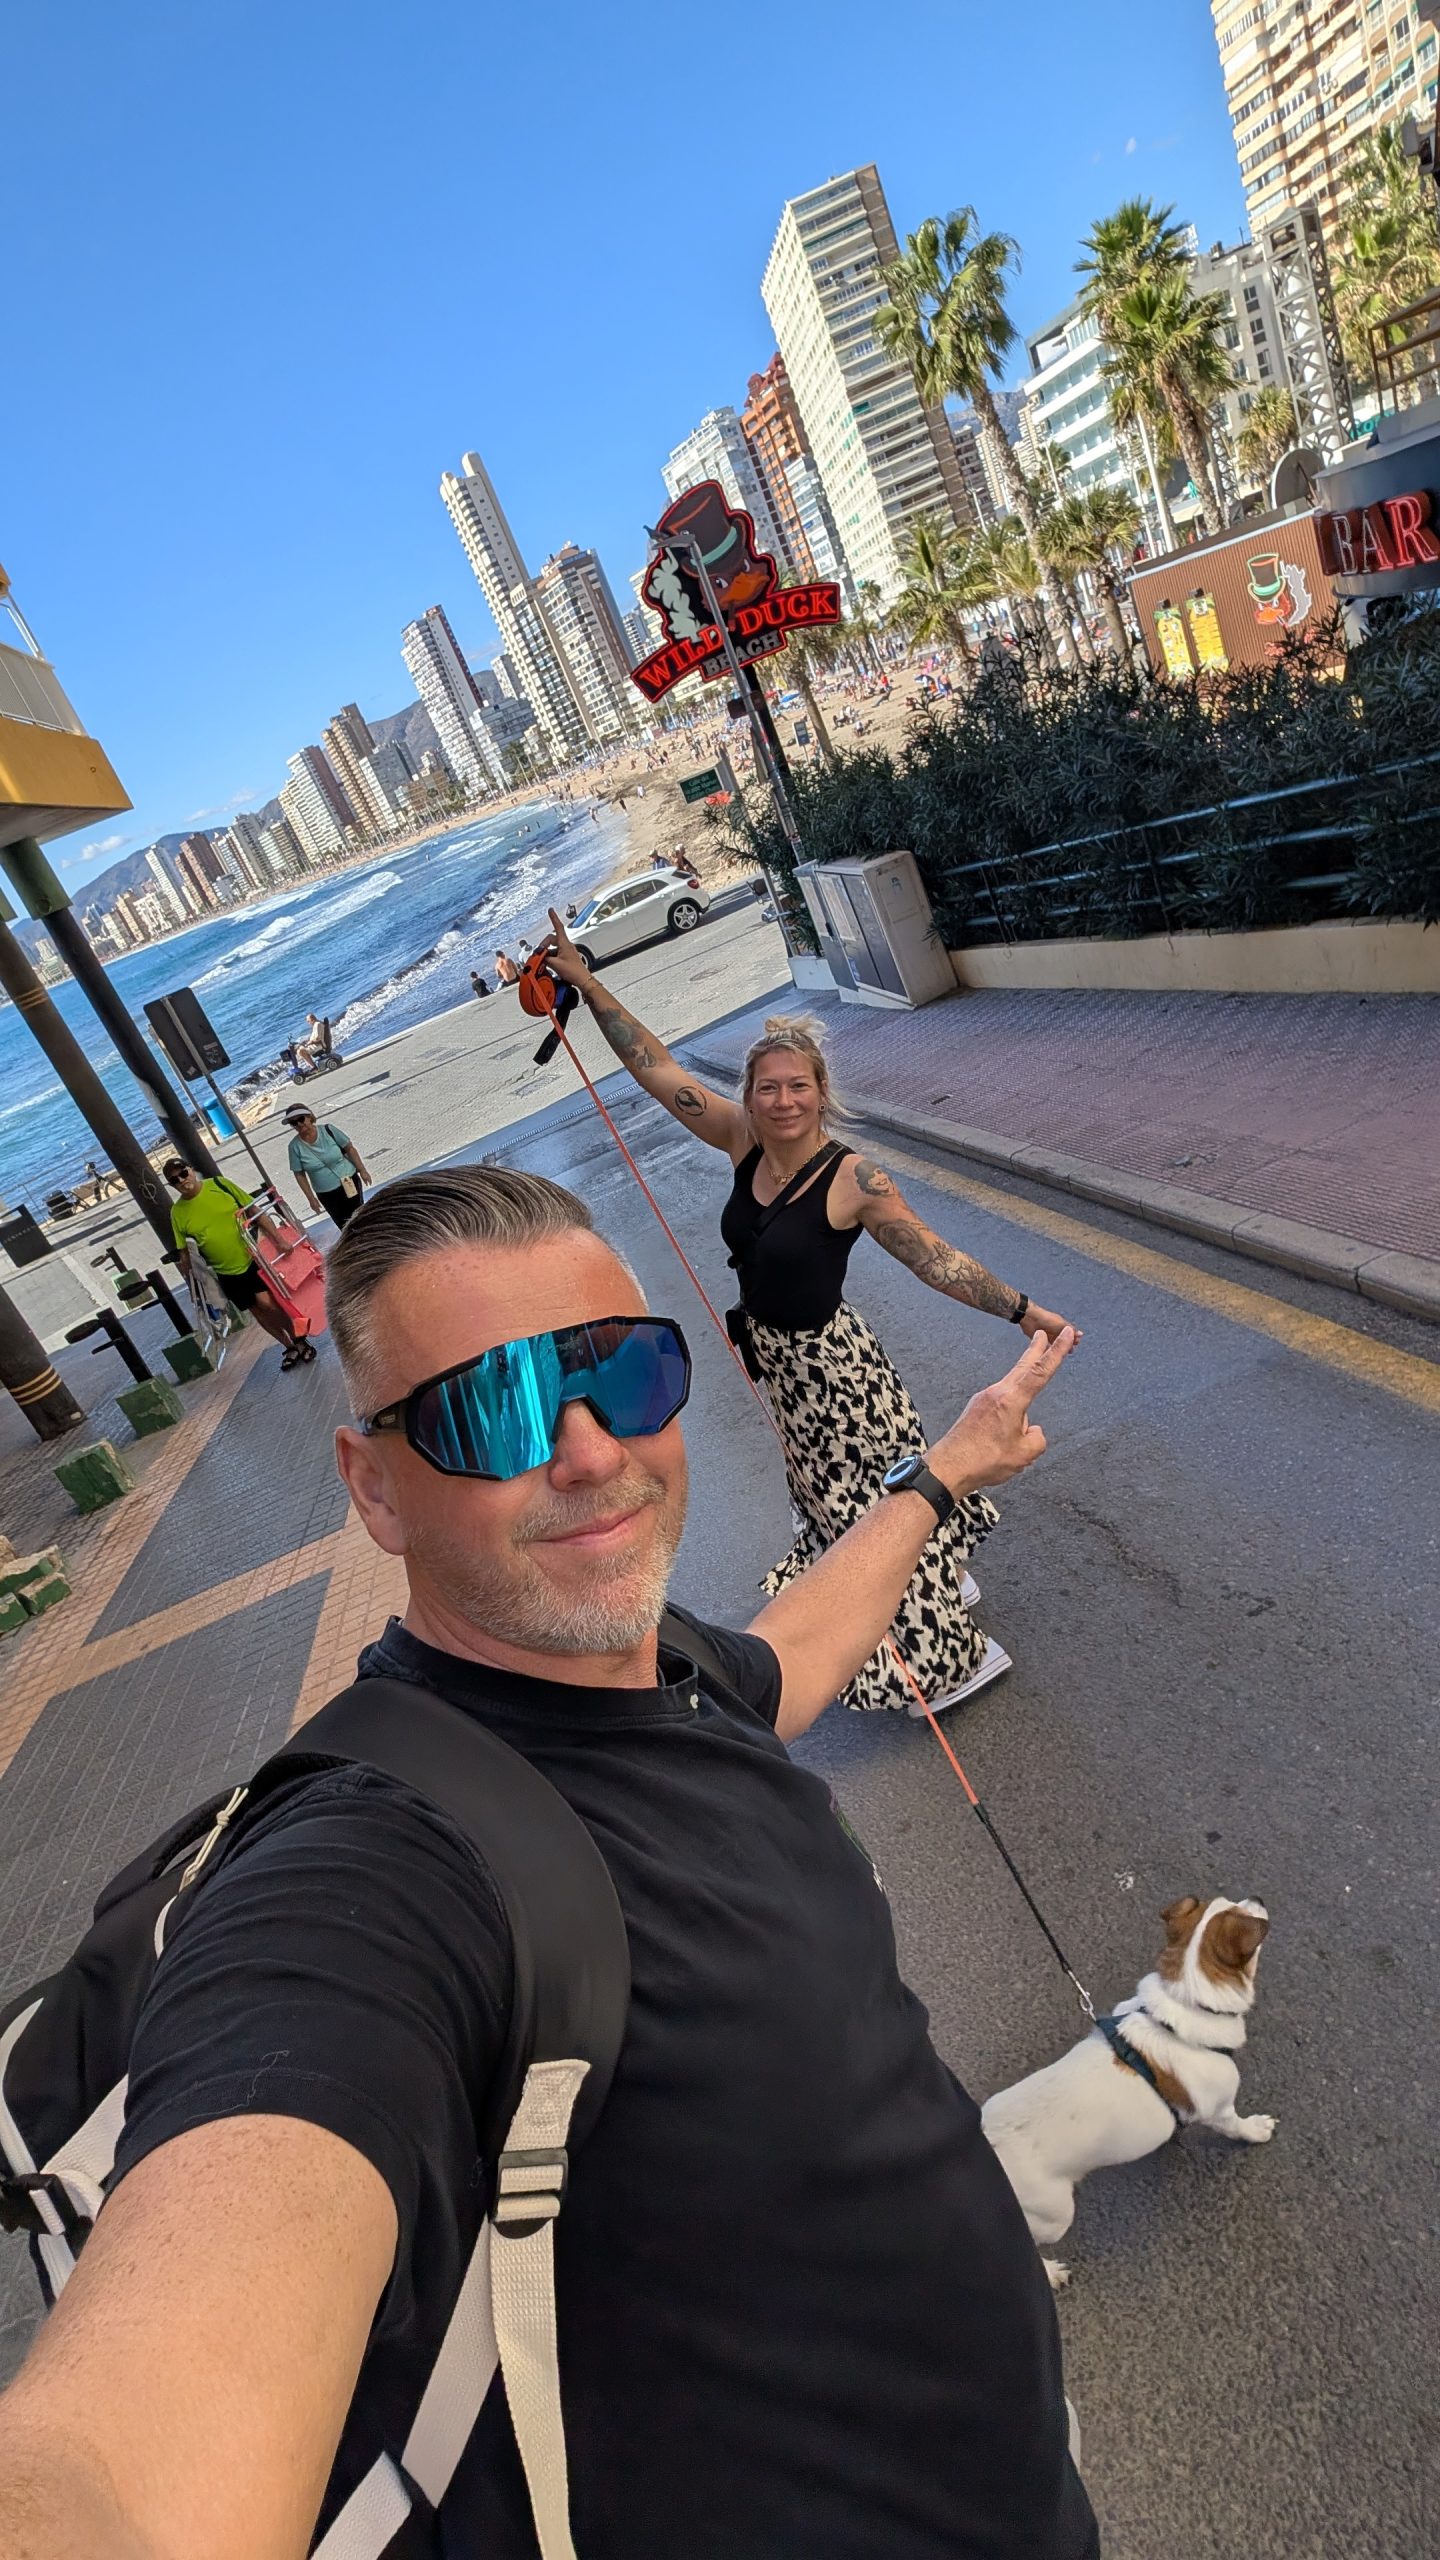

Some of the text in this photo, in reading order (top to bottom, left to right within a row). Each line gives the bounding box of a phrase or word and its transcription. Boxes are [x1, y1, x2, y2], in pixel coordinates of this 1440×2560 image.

[1332, 496, 1439, 575] BAR
[639, 590, 836, 687] WILD DUCK
[702, 630, 782, 677] BEACH
